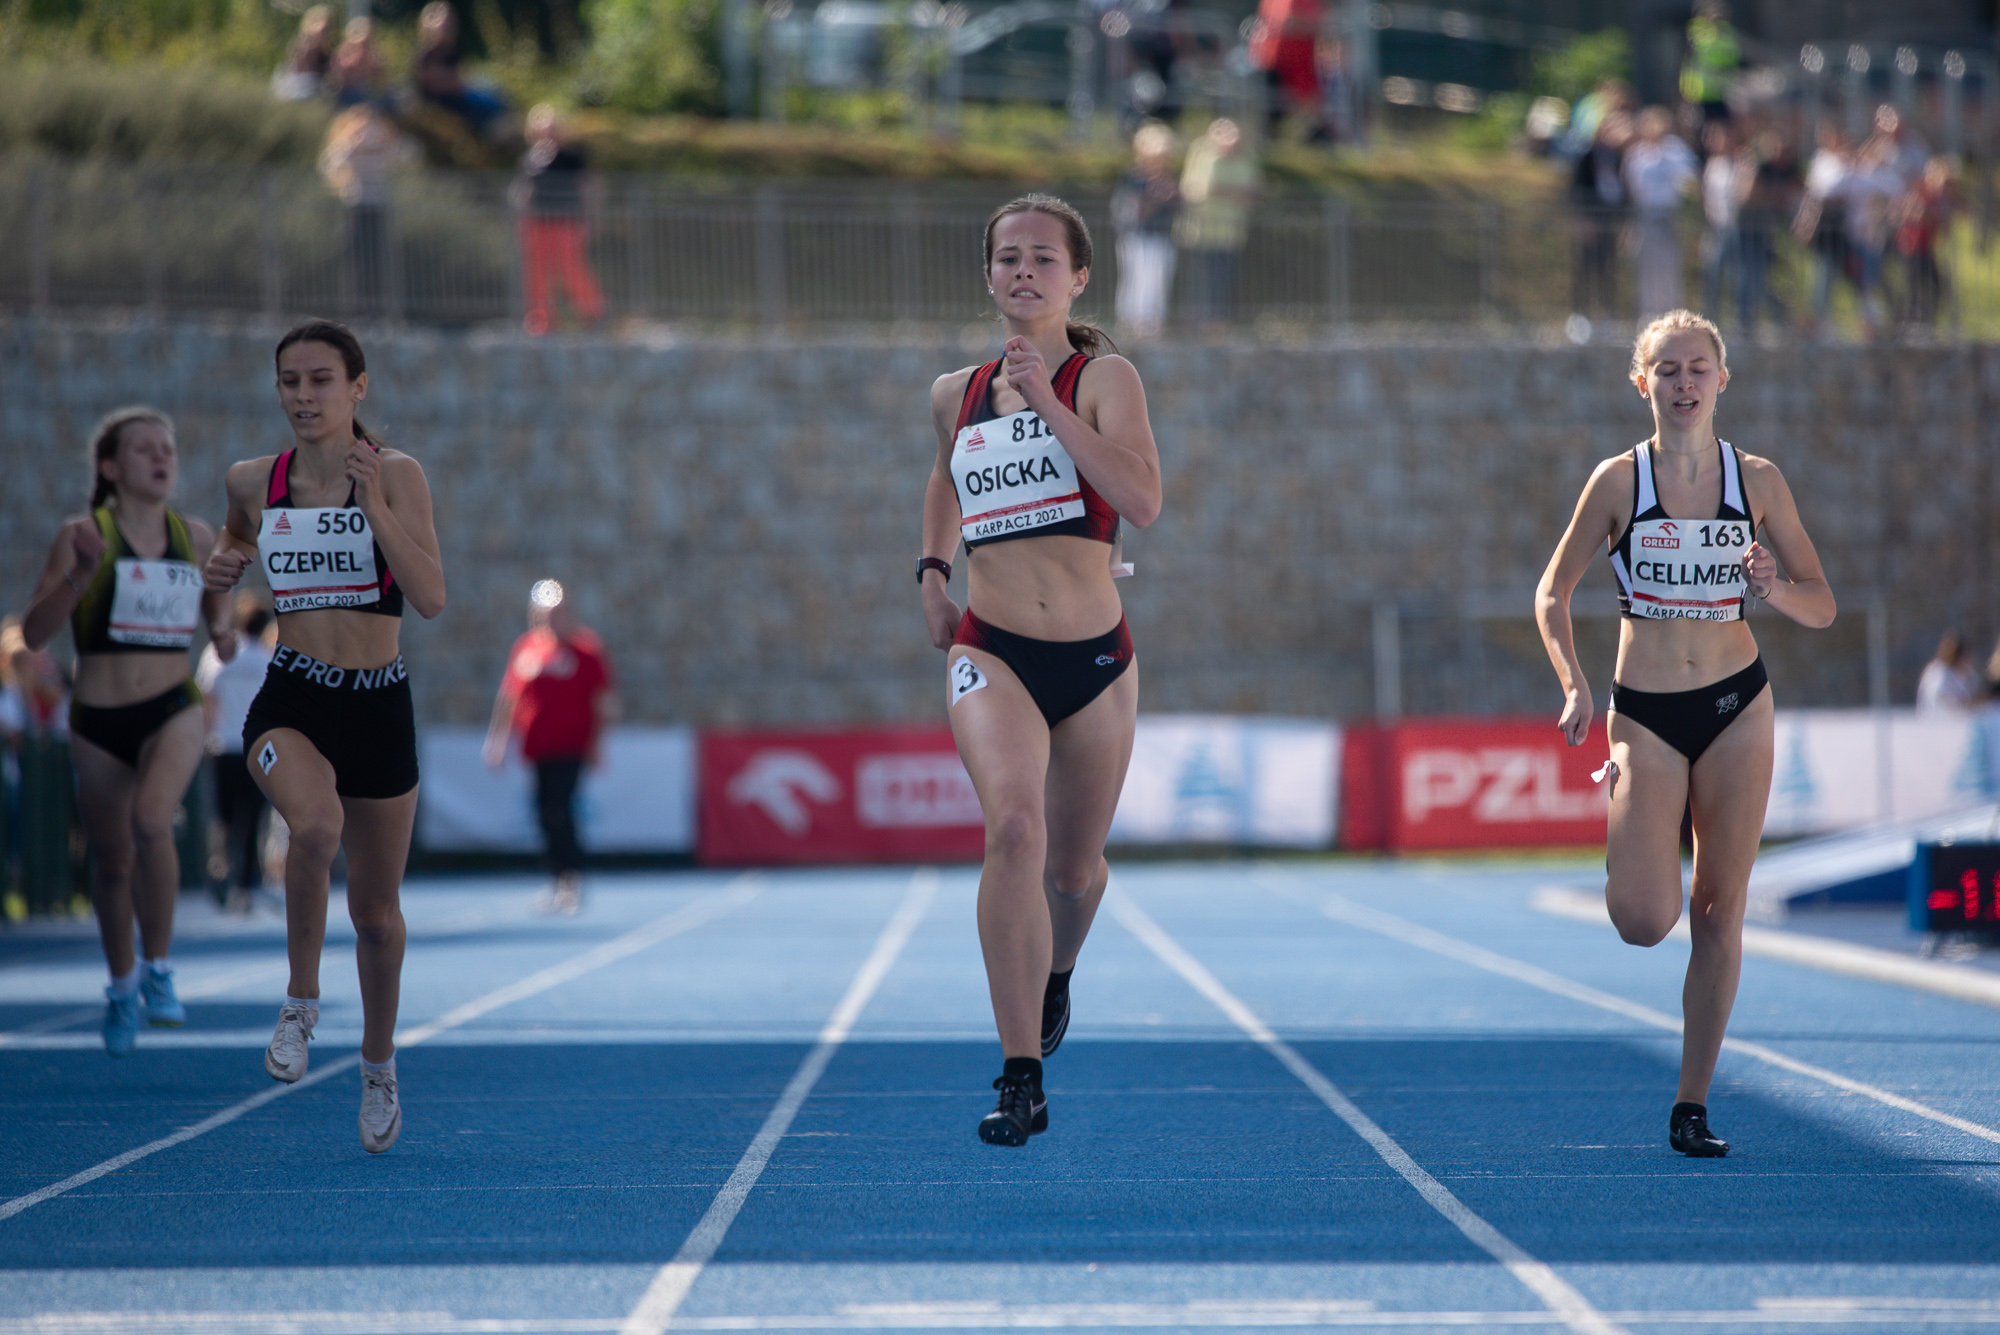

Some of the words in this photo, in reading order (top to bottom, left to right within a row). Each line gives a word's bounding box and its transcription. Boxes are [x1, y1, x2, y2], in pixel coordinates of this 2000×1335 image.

[965, 456, 1061, 497] OSICKA
[317, 512, 365, 535] 550
[975, 515, 1032, 537] KARPACZ
[1035, 507, 1065, 525] 2021
[1643, 538, 1678, 548] ORLEN
[1699, 525, 1746, 548] 163
[268, 551, 363, 575] CZEPIEL
[1635, 561, 1742, 586] CELLMER
[334, 594, 361, 608] 2021
[1645, 605, 1702, 620] KARPACZ
[1705, 609, 1729, 621] 2021
[288, 653, 346, 688] PRO
[353, 654, 407, 690] NIKE
[958, 663, 979, 694] 3
